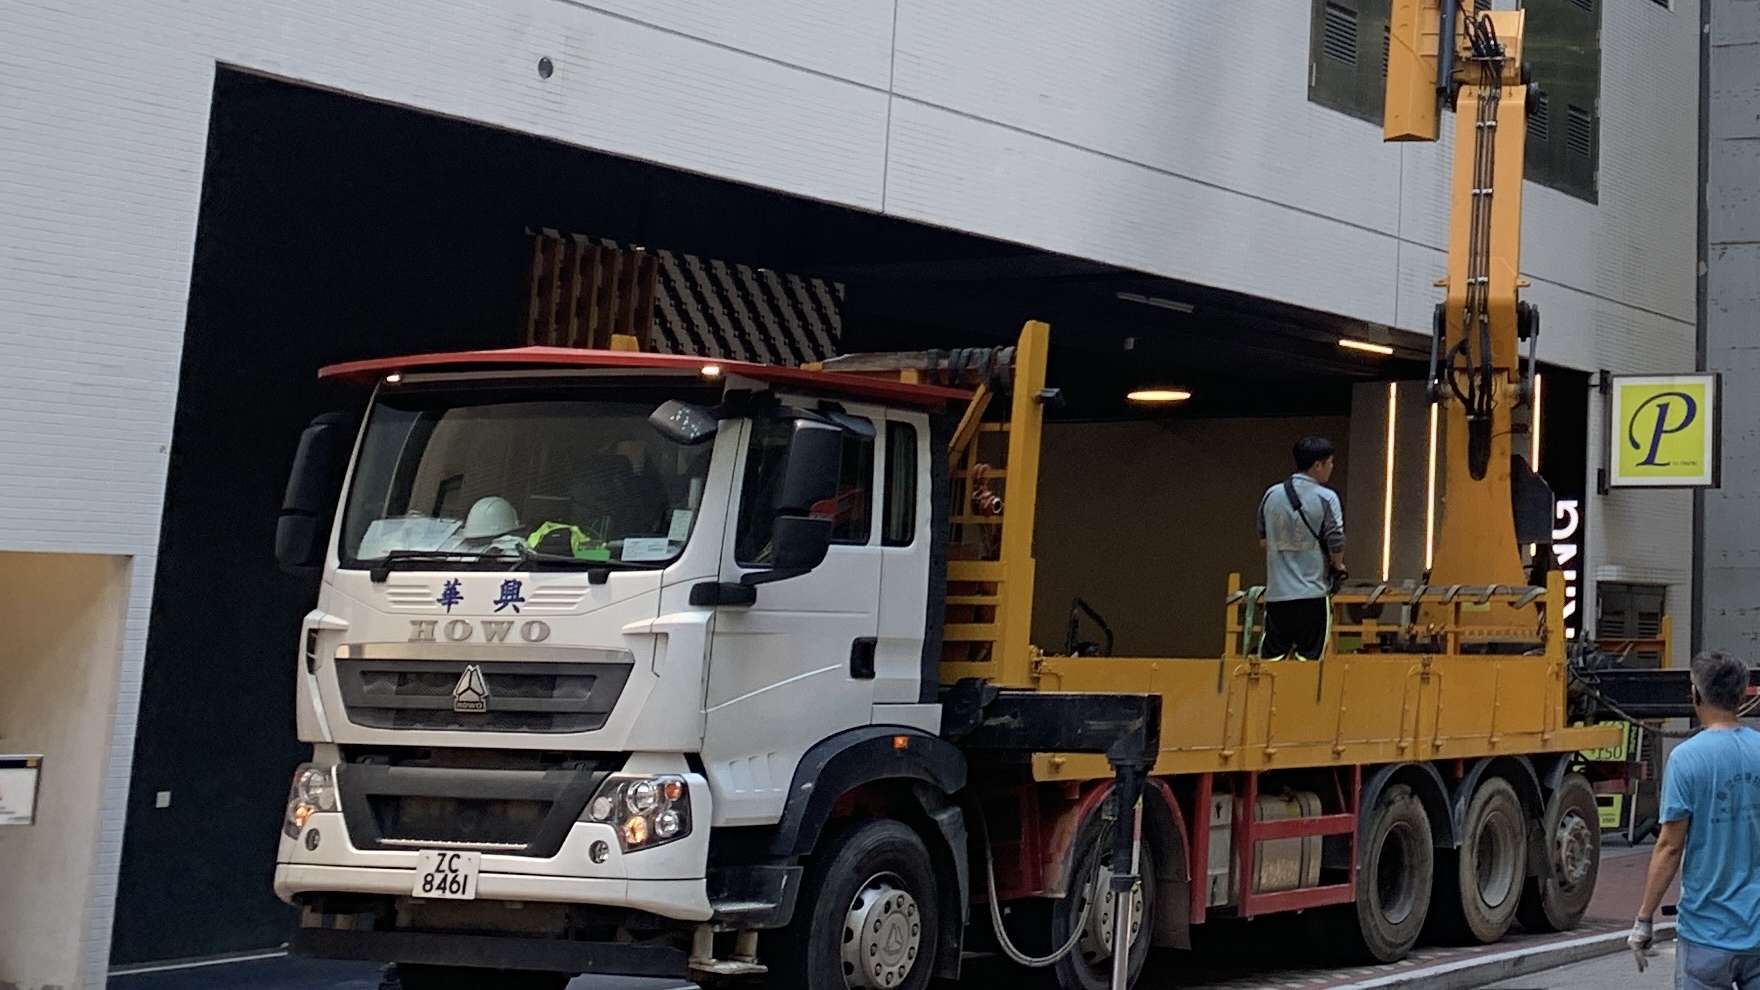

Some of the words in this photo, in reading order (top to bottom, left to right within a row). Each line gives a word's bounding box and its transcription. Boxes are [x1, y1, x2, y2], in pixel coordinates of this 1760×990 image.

[1628, 391, 1697, 467] P
[436, 578, 525, 614] 華興
[408, 619, 551, 643] HOWO
[434, 853, 461, 873] ZC
[422, 873, 468, 895] 8461
